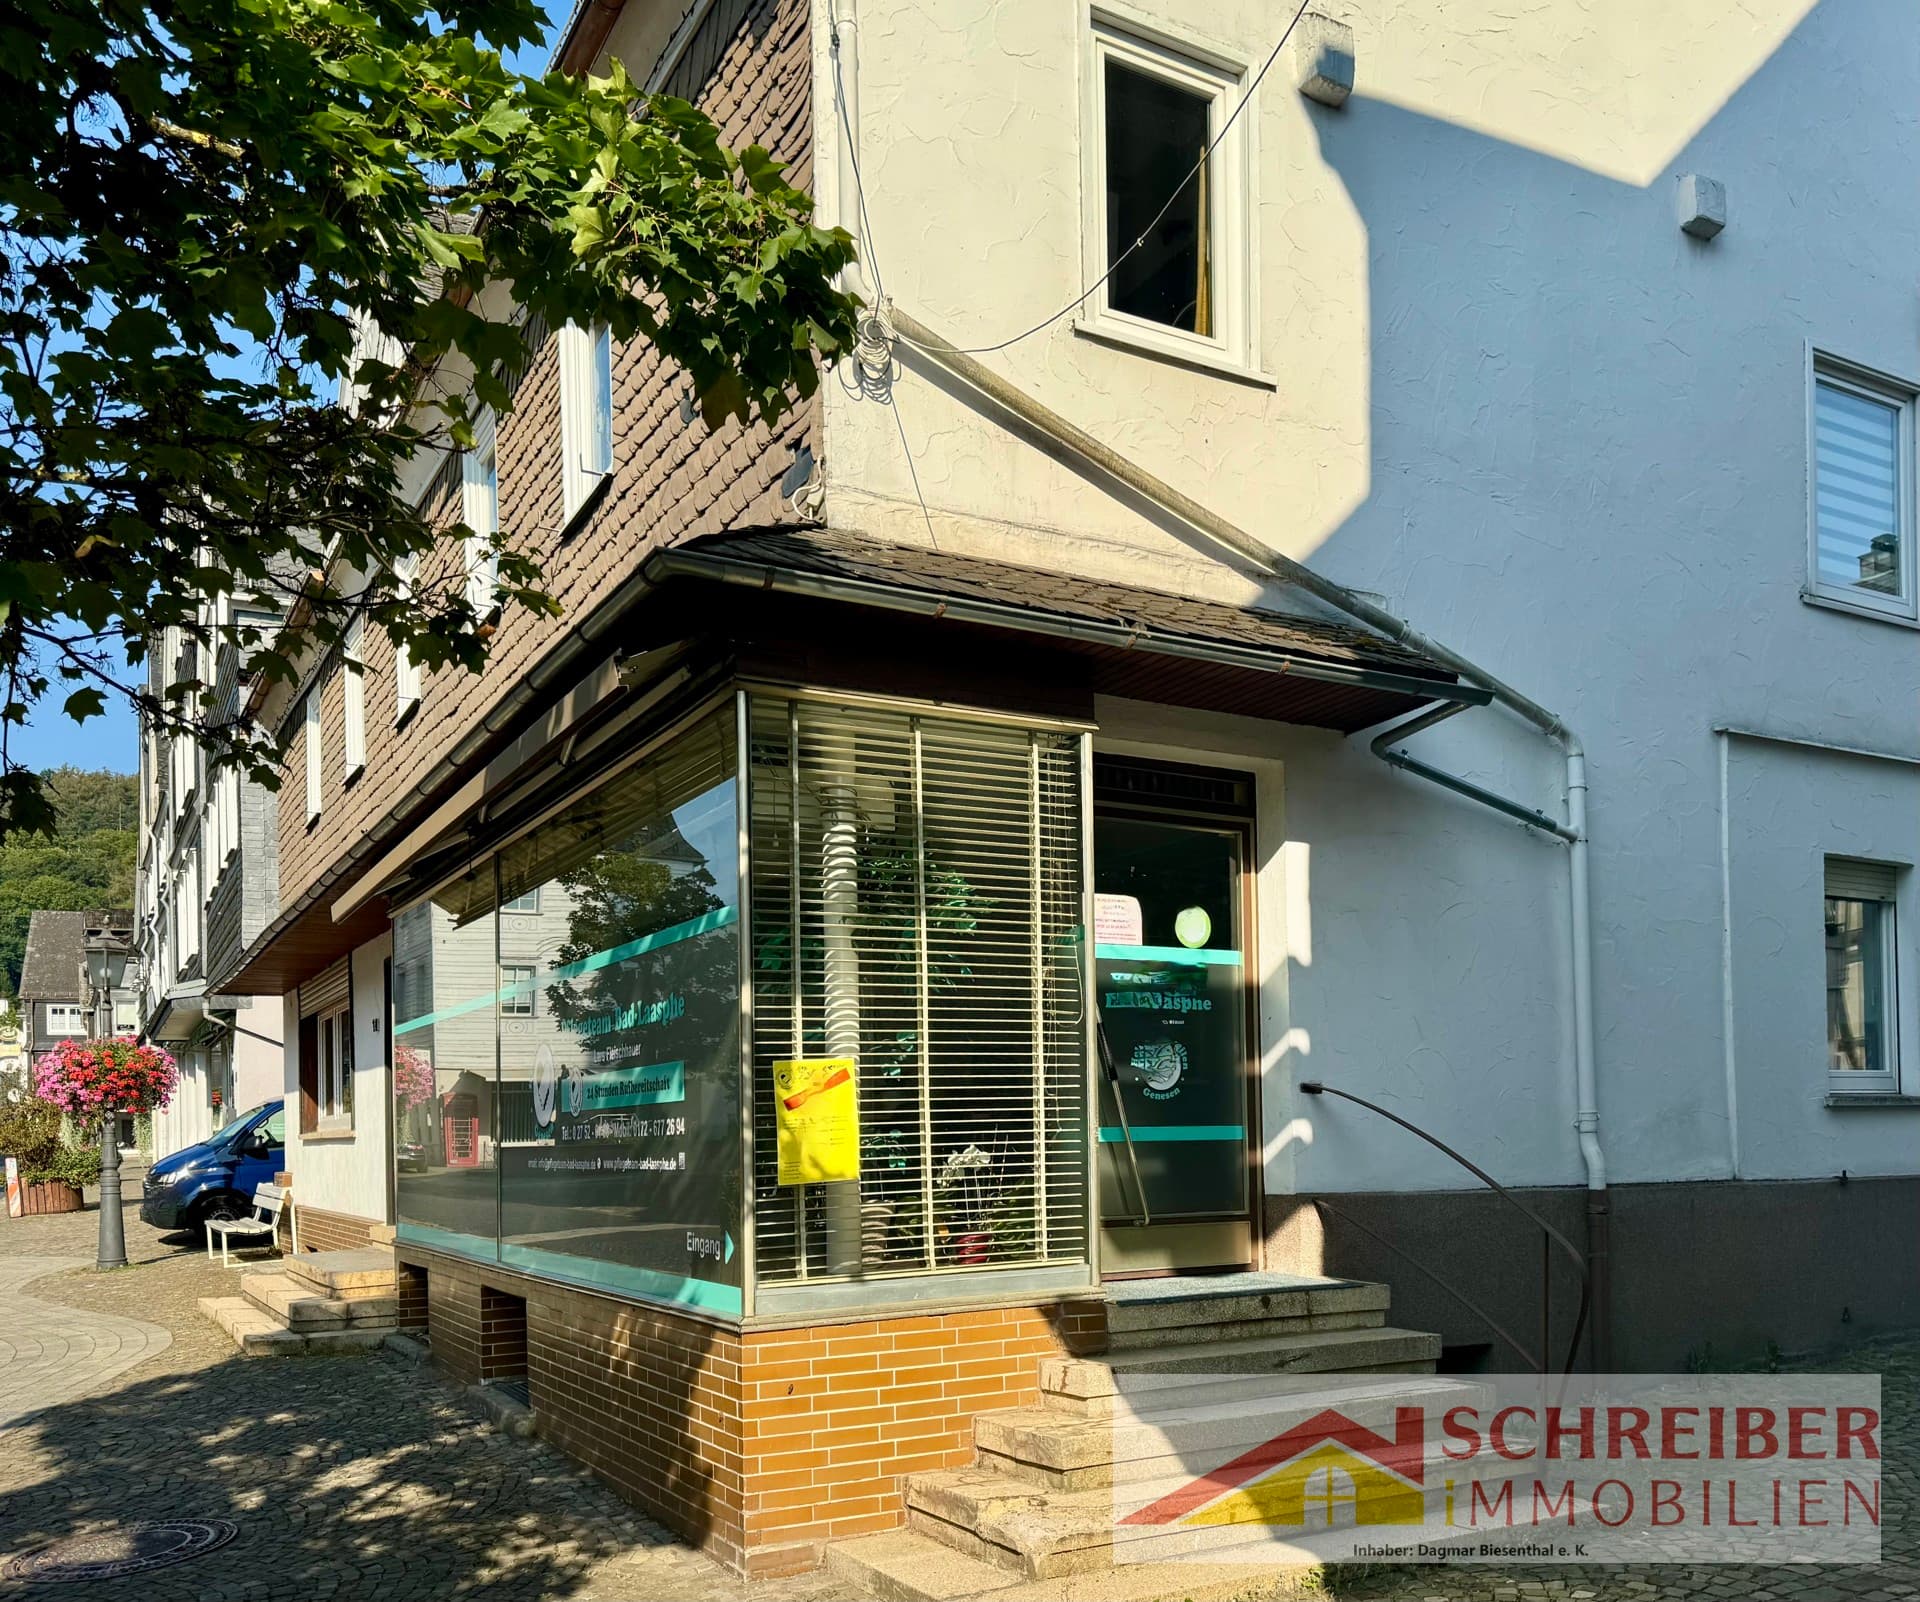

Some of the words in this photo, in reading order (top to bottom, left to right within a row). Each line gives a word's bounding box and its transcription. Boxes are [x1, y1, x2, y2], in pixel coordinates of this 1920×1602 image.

[586, 1086, 594, 1100] 24
[595, 1081, 619, 1098] Stunden
[1143, 1087, 1181, 1100] Genesen
[686, 1231, 720, 1261] Eingang
